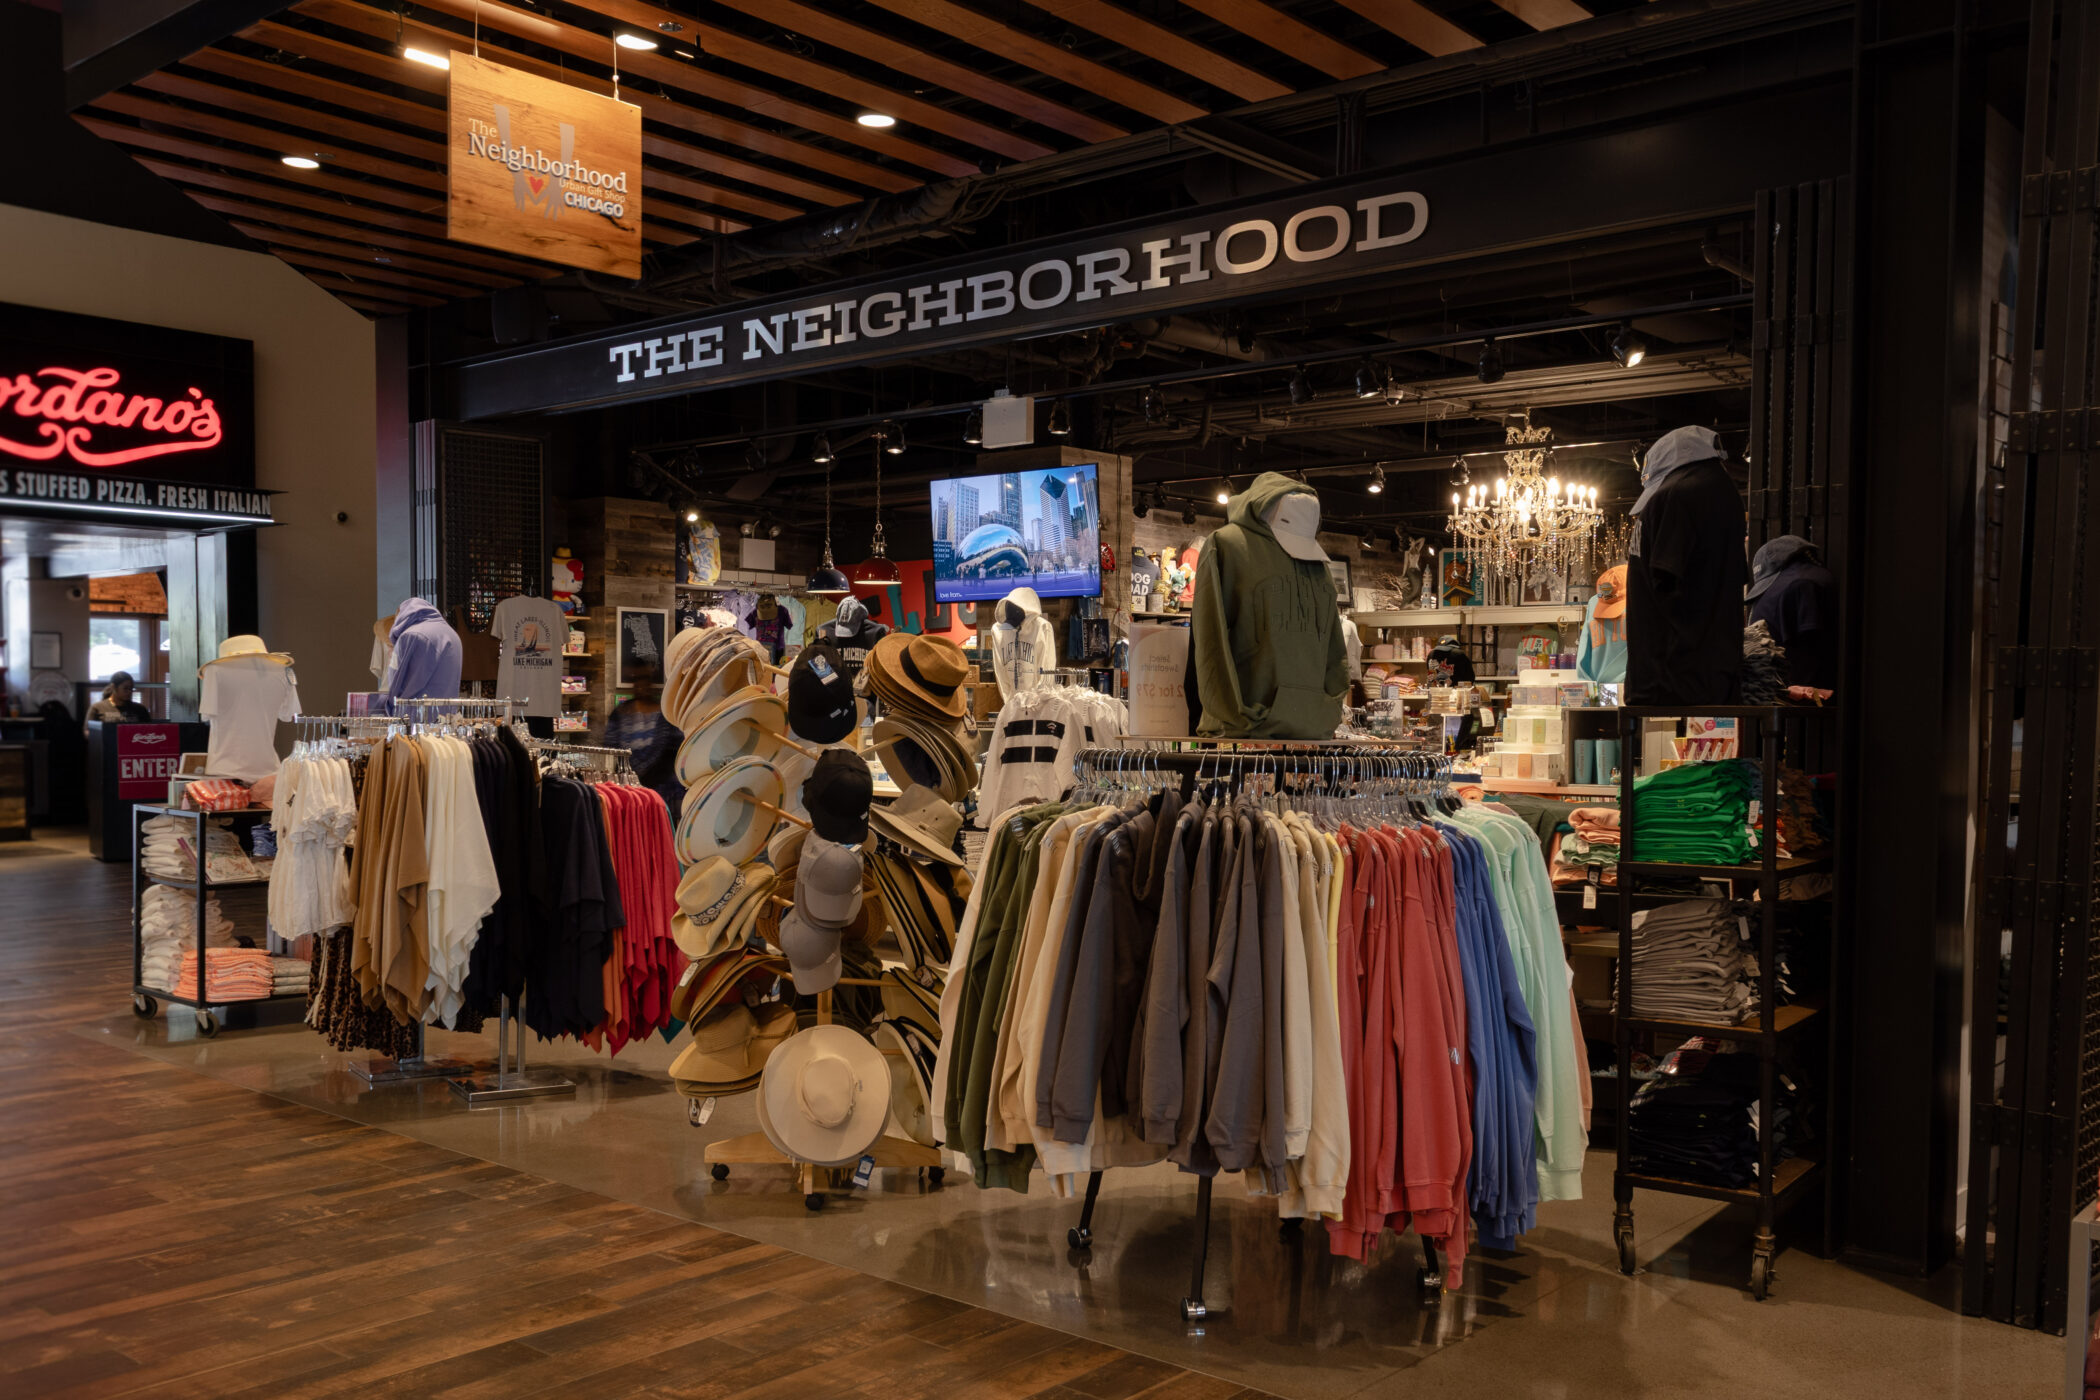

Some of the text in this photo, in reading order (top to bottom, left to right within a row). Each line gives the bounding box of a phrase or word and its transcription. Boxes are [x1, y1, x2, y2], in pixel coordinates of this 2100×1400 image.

[468, 118, 497, 138] The
[468, 132, 628, 194] Neighborhood
[559, 177, 626, 204] Urban Gift Shop
[564, 191, 624, 218] CHICAGO
[609, 191, 1430, 384] THE NEIGHBORHOOD
[15, 471, 91, 500] STUFFED
[97, 478, 153, 506] PIZZA.
[158, 485, 209, 510] FRESH
[214, 490, 272, 515] ITALIAN
[525, 657, 553, 667] MICHIGAN
[121, 758, 178, 779] ENTER
